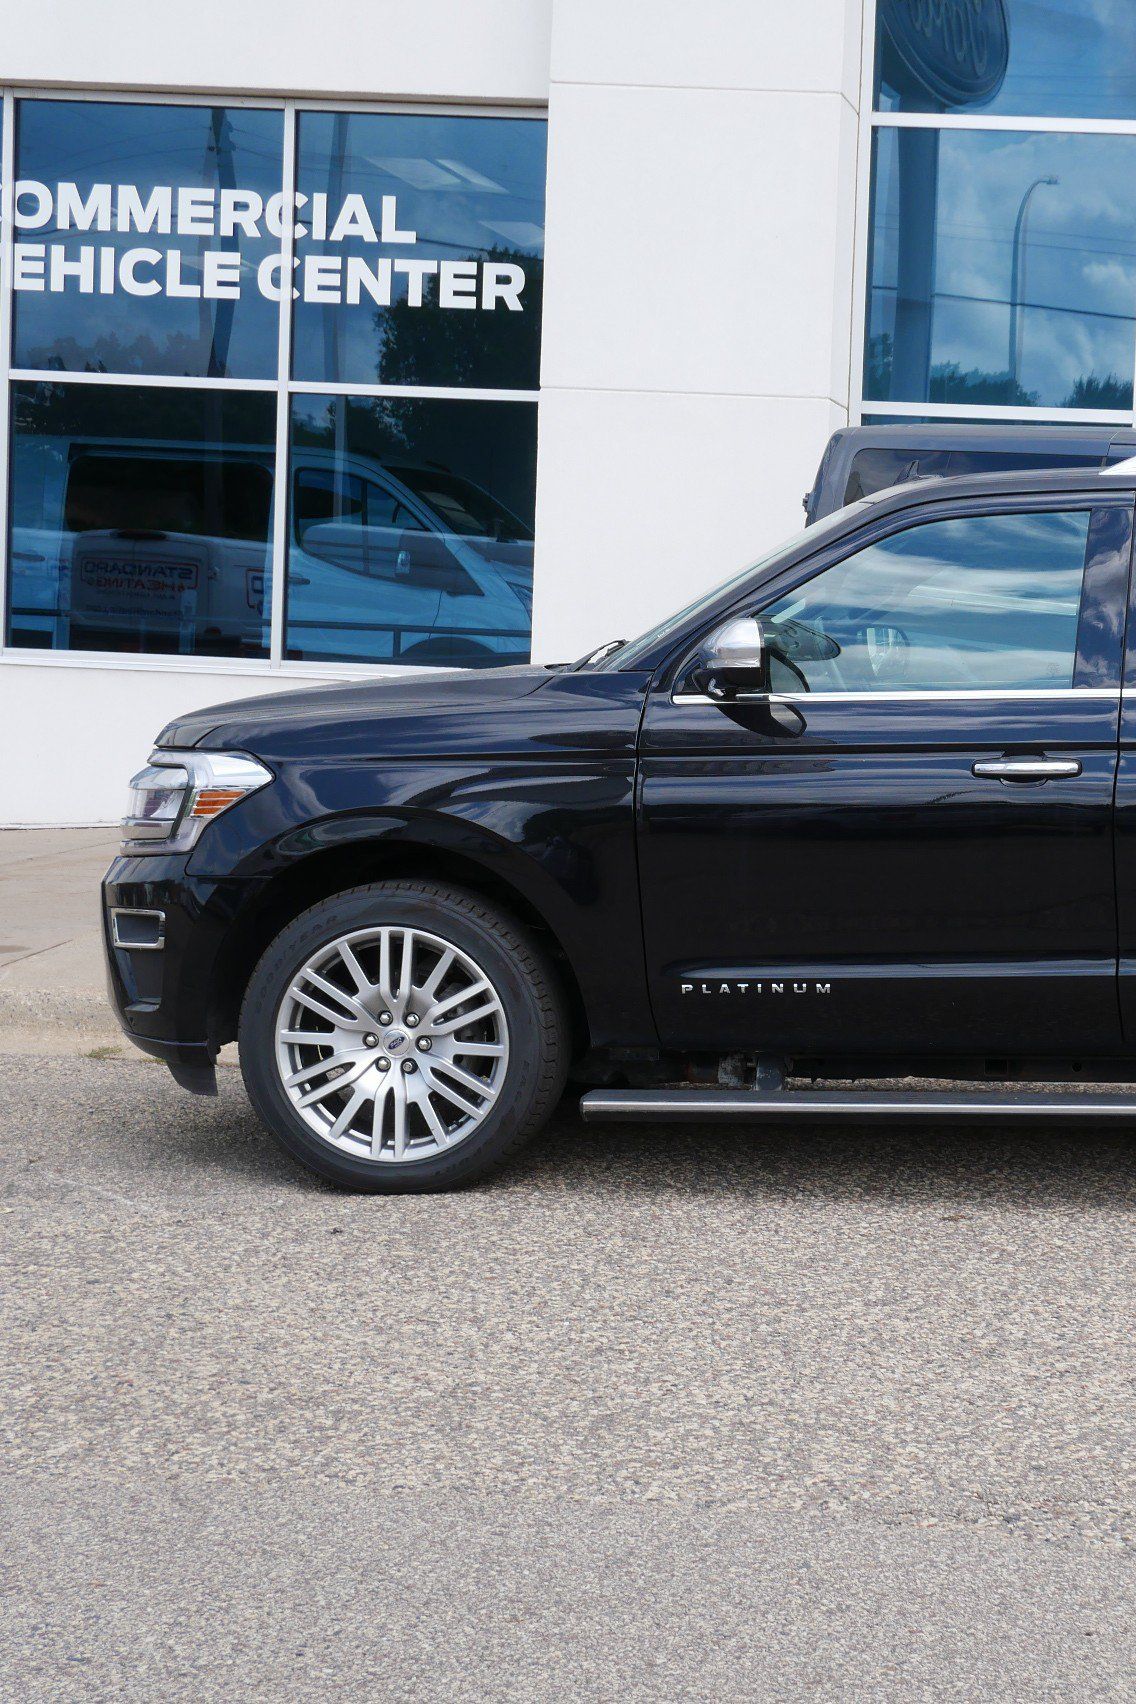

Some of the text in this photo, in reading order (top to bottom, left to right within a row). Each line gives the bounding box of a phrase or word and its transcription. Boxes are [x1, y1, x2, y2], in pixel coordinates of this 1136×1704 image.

[0, 180, 417, 244] OMMERCIAL
[0, 243, 526, 312] EHICLE CENTER
[681, 983, 831, 994] PLATINUM
